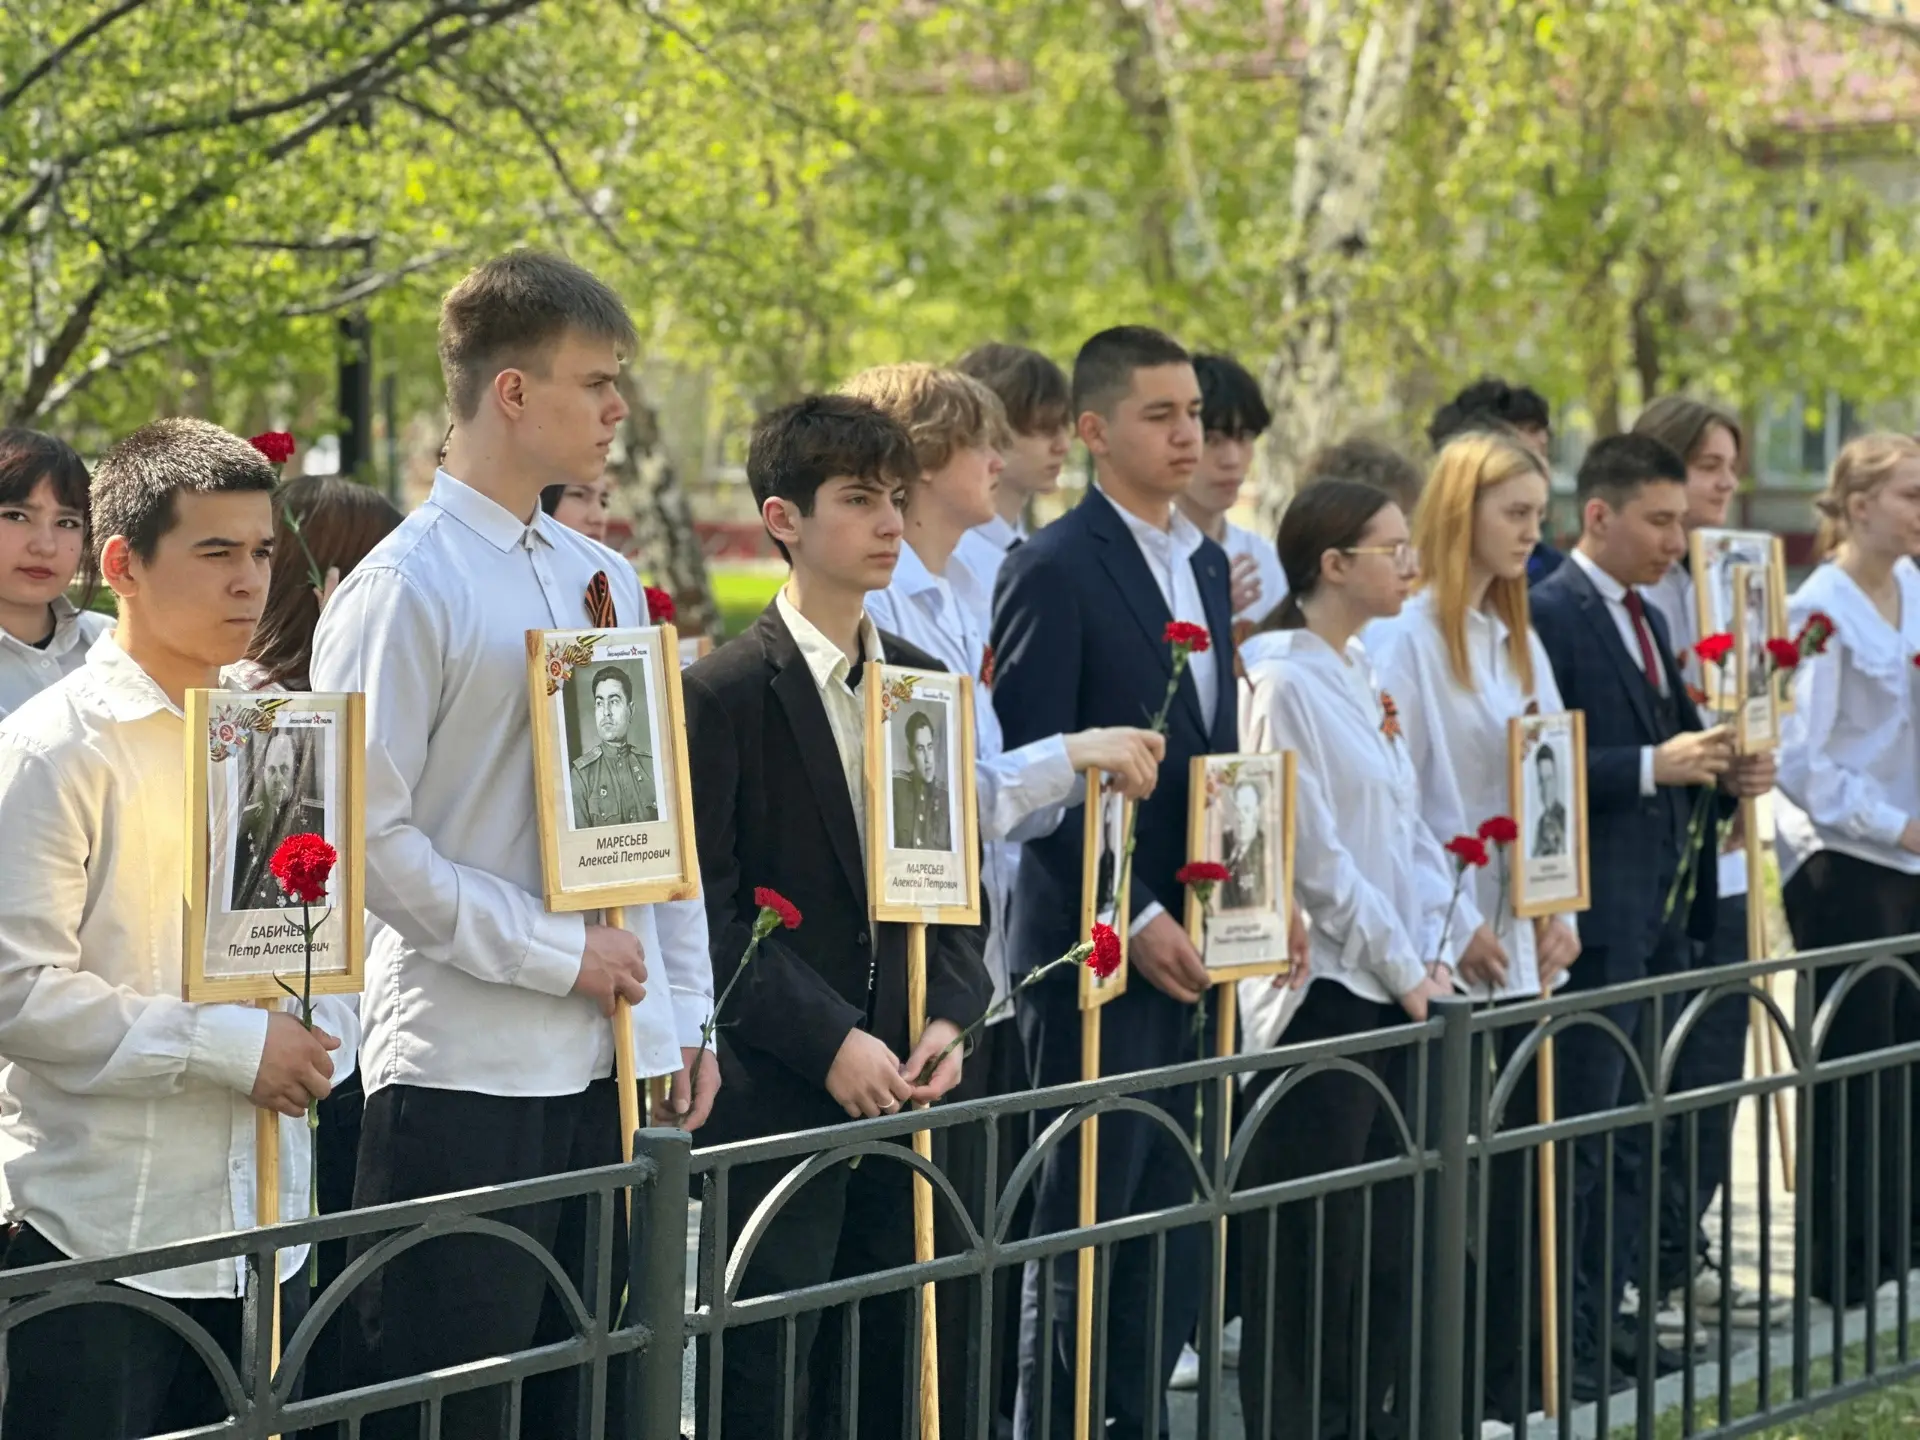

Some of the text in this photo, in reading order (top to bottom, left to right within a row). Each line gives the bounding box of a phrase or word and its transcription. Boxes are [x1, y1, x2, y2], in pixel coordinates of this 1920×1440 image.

[596, 833, 648, 850] МАРЕСЬЕВ
[578, 848, 671, 868] Алексей Петрович
[906, 863, 945, 875] МАРЕСЬЕВ
[892, 876, 958, 891] Алексей Петрович
[250, 924, 305, 939] БАБИЧЕВ
[228, 943, 261, 959] Петр
